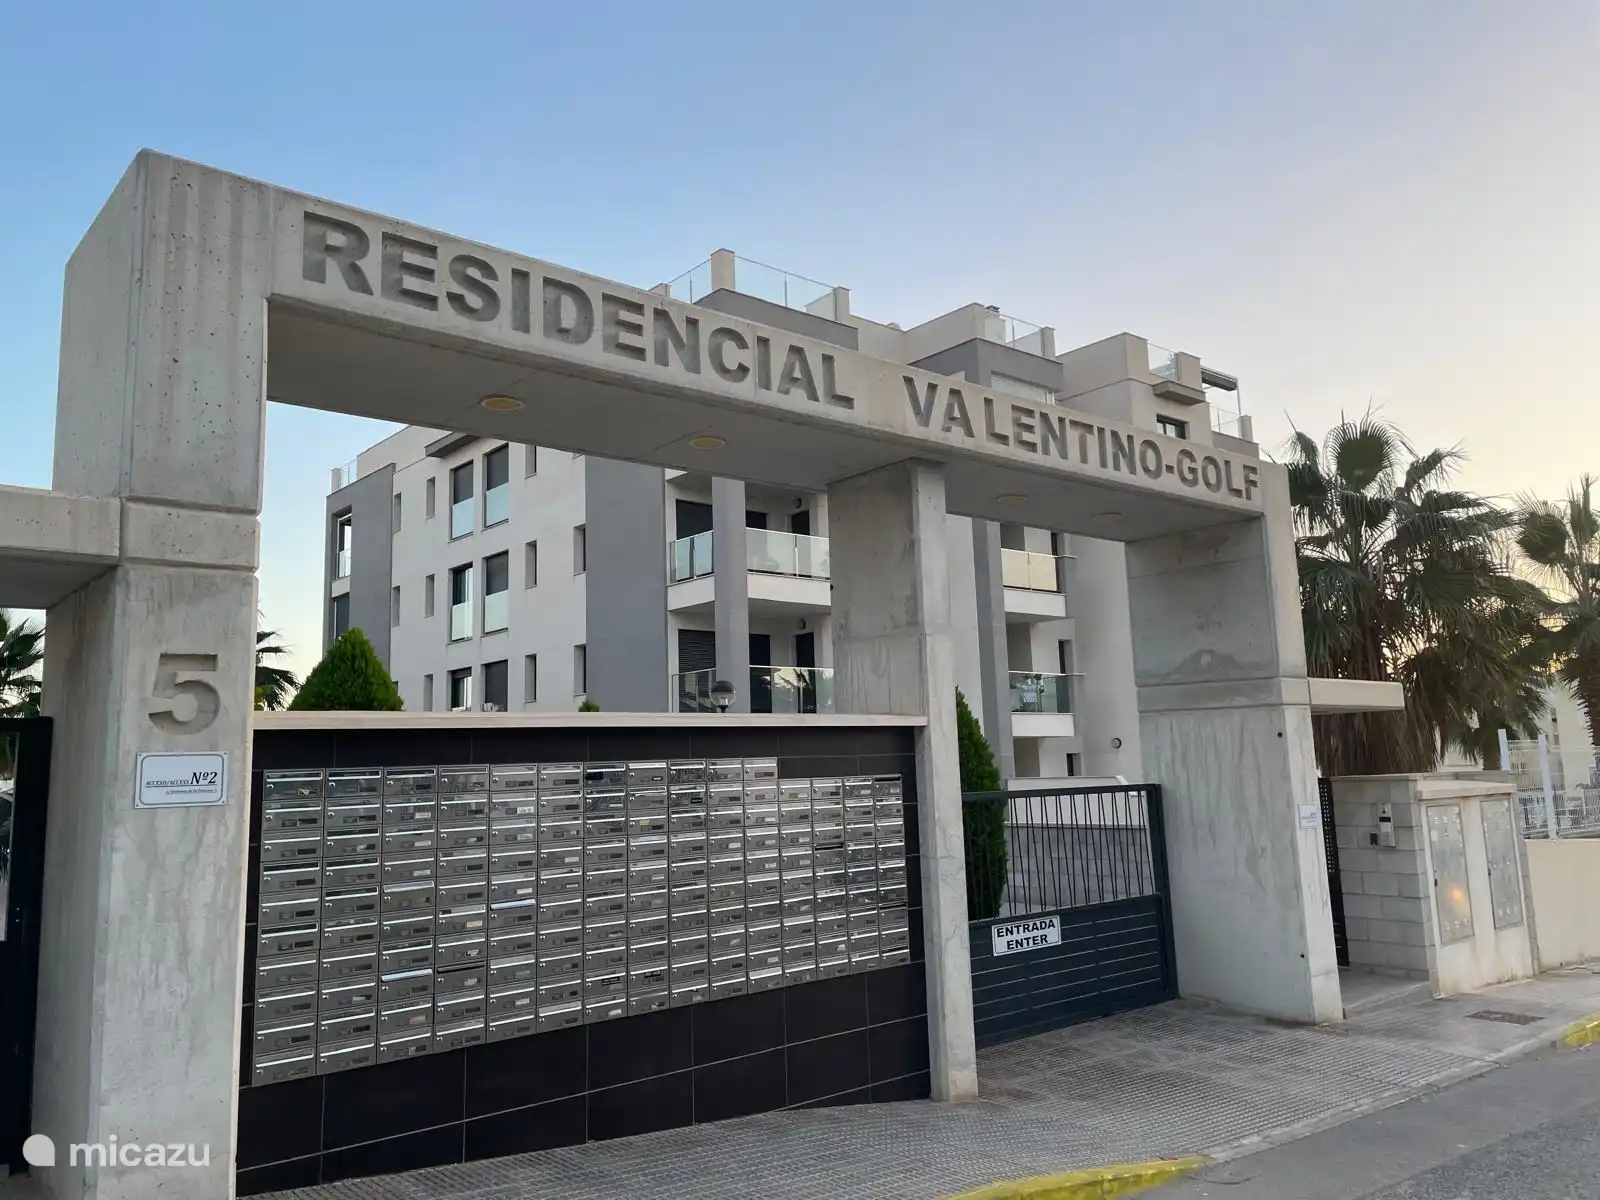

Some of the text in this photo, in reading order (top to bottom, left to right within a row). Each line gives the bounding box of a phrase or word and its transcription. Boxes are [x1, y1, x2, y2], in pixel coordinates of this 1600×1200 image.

[303, 210, 1260, 501] RESIDENCIAL VALENTINO-GOLF
[148, 653, 221, 735] 5
[996, 919, 1056, 938] ENTRADA
[1006, 934, 1048, 950] ENTER
